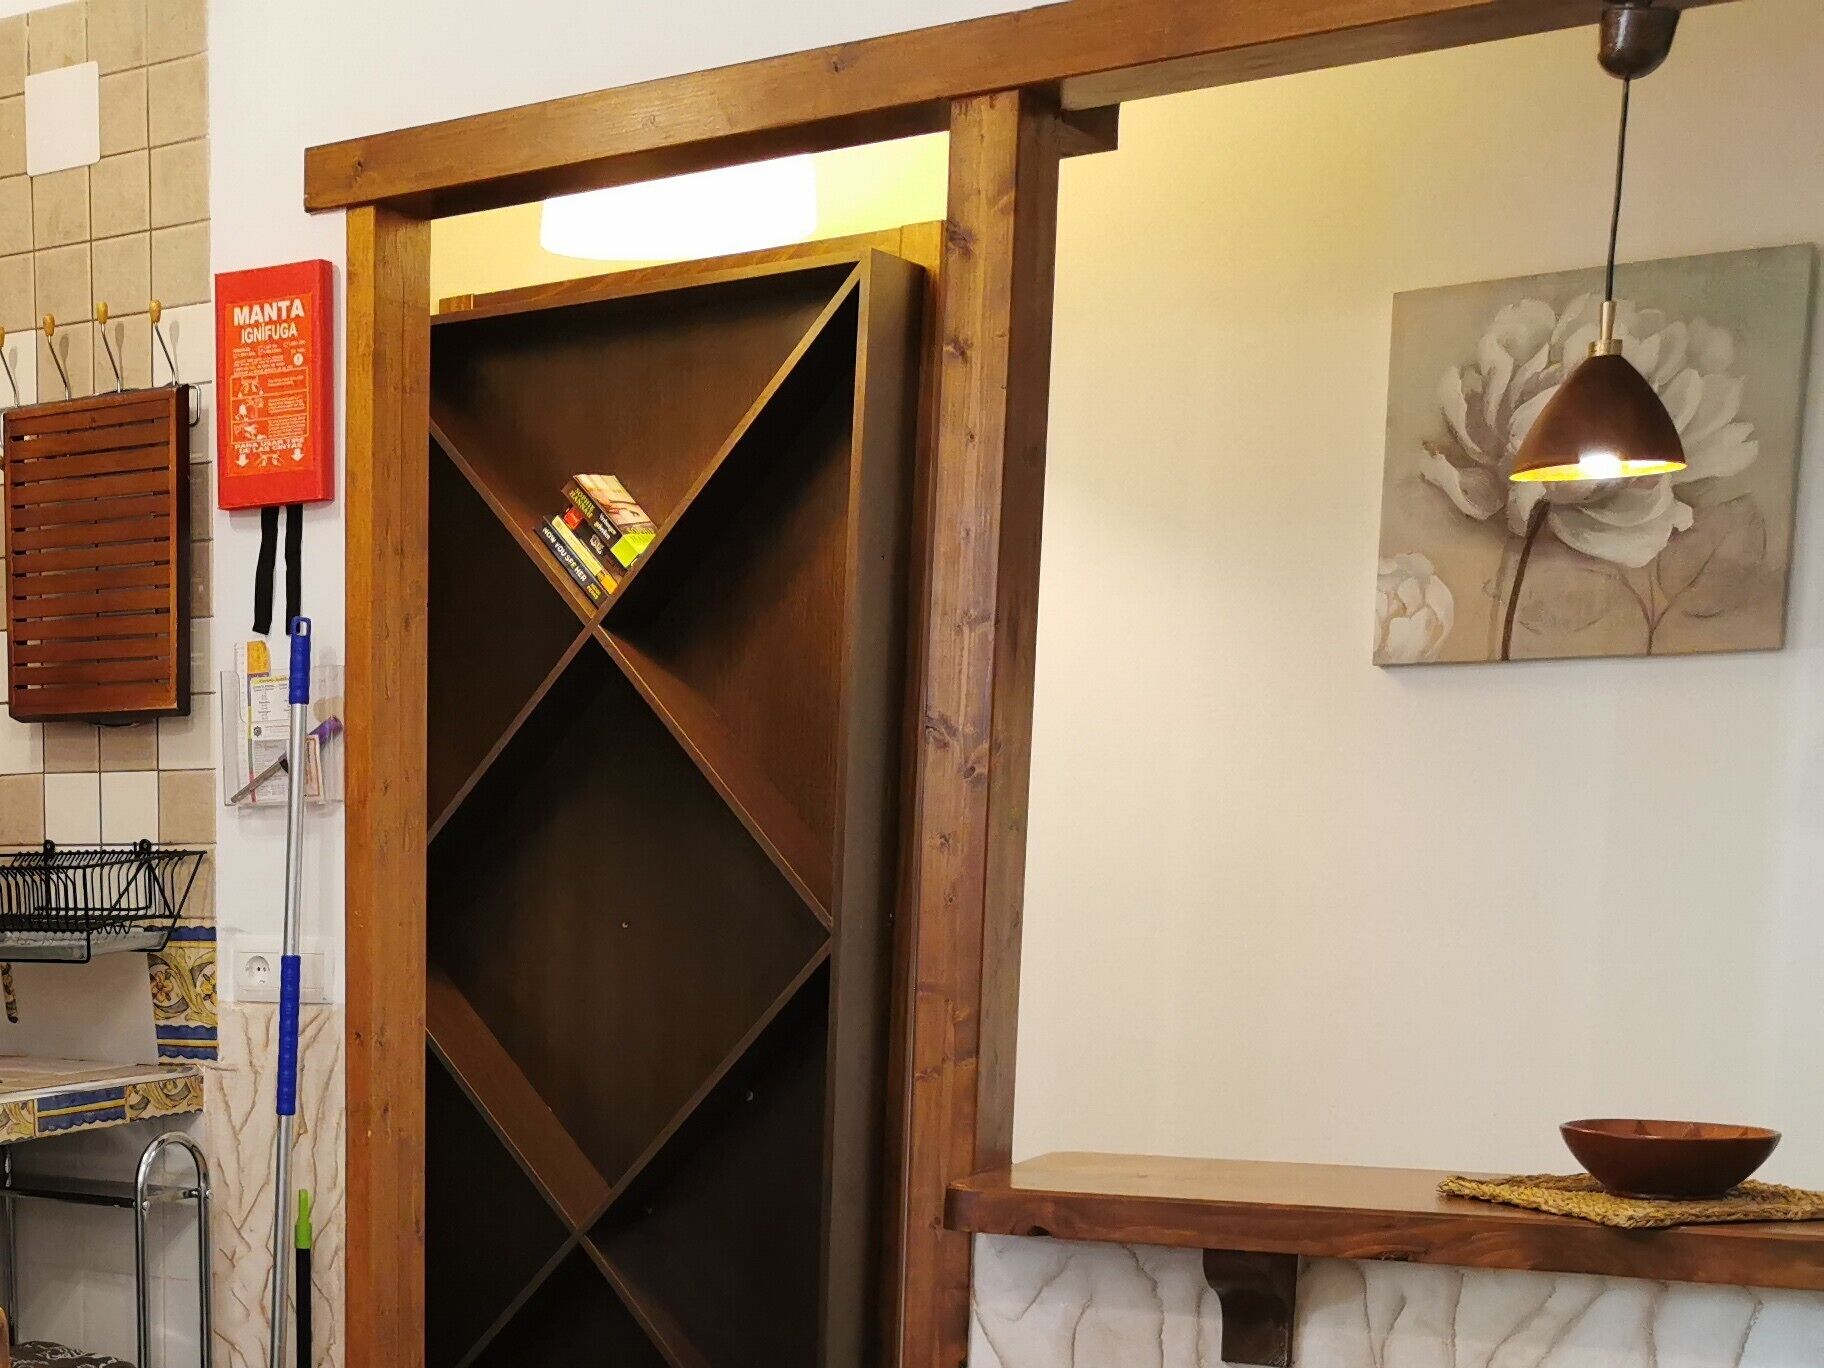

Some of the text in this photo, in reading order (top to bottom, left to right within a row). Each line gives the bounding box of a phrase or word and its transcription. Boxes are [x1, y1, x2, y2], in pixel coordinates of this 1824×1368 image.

[233, 298, 305, 327] MANTA
[241, 322, 298, 344] IGNÍFUGA
[542, 528, 587, 582] NOW YOU SEE HER
